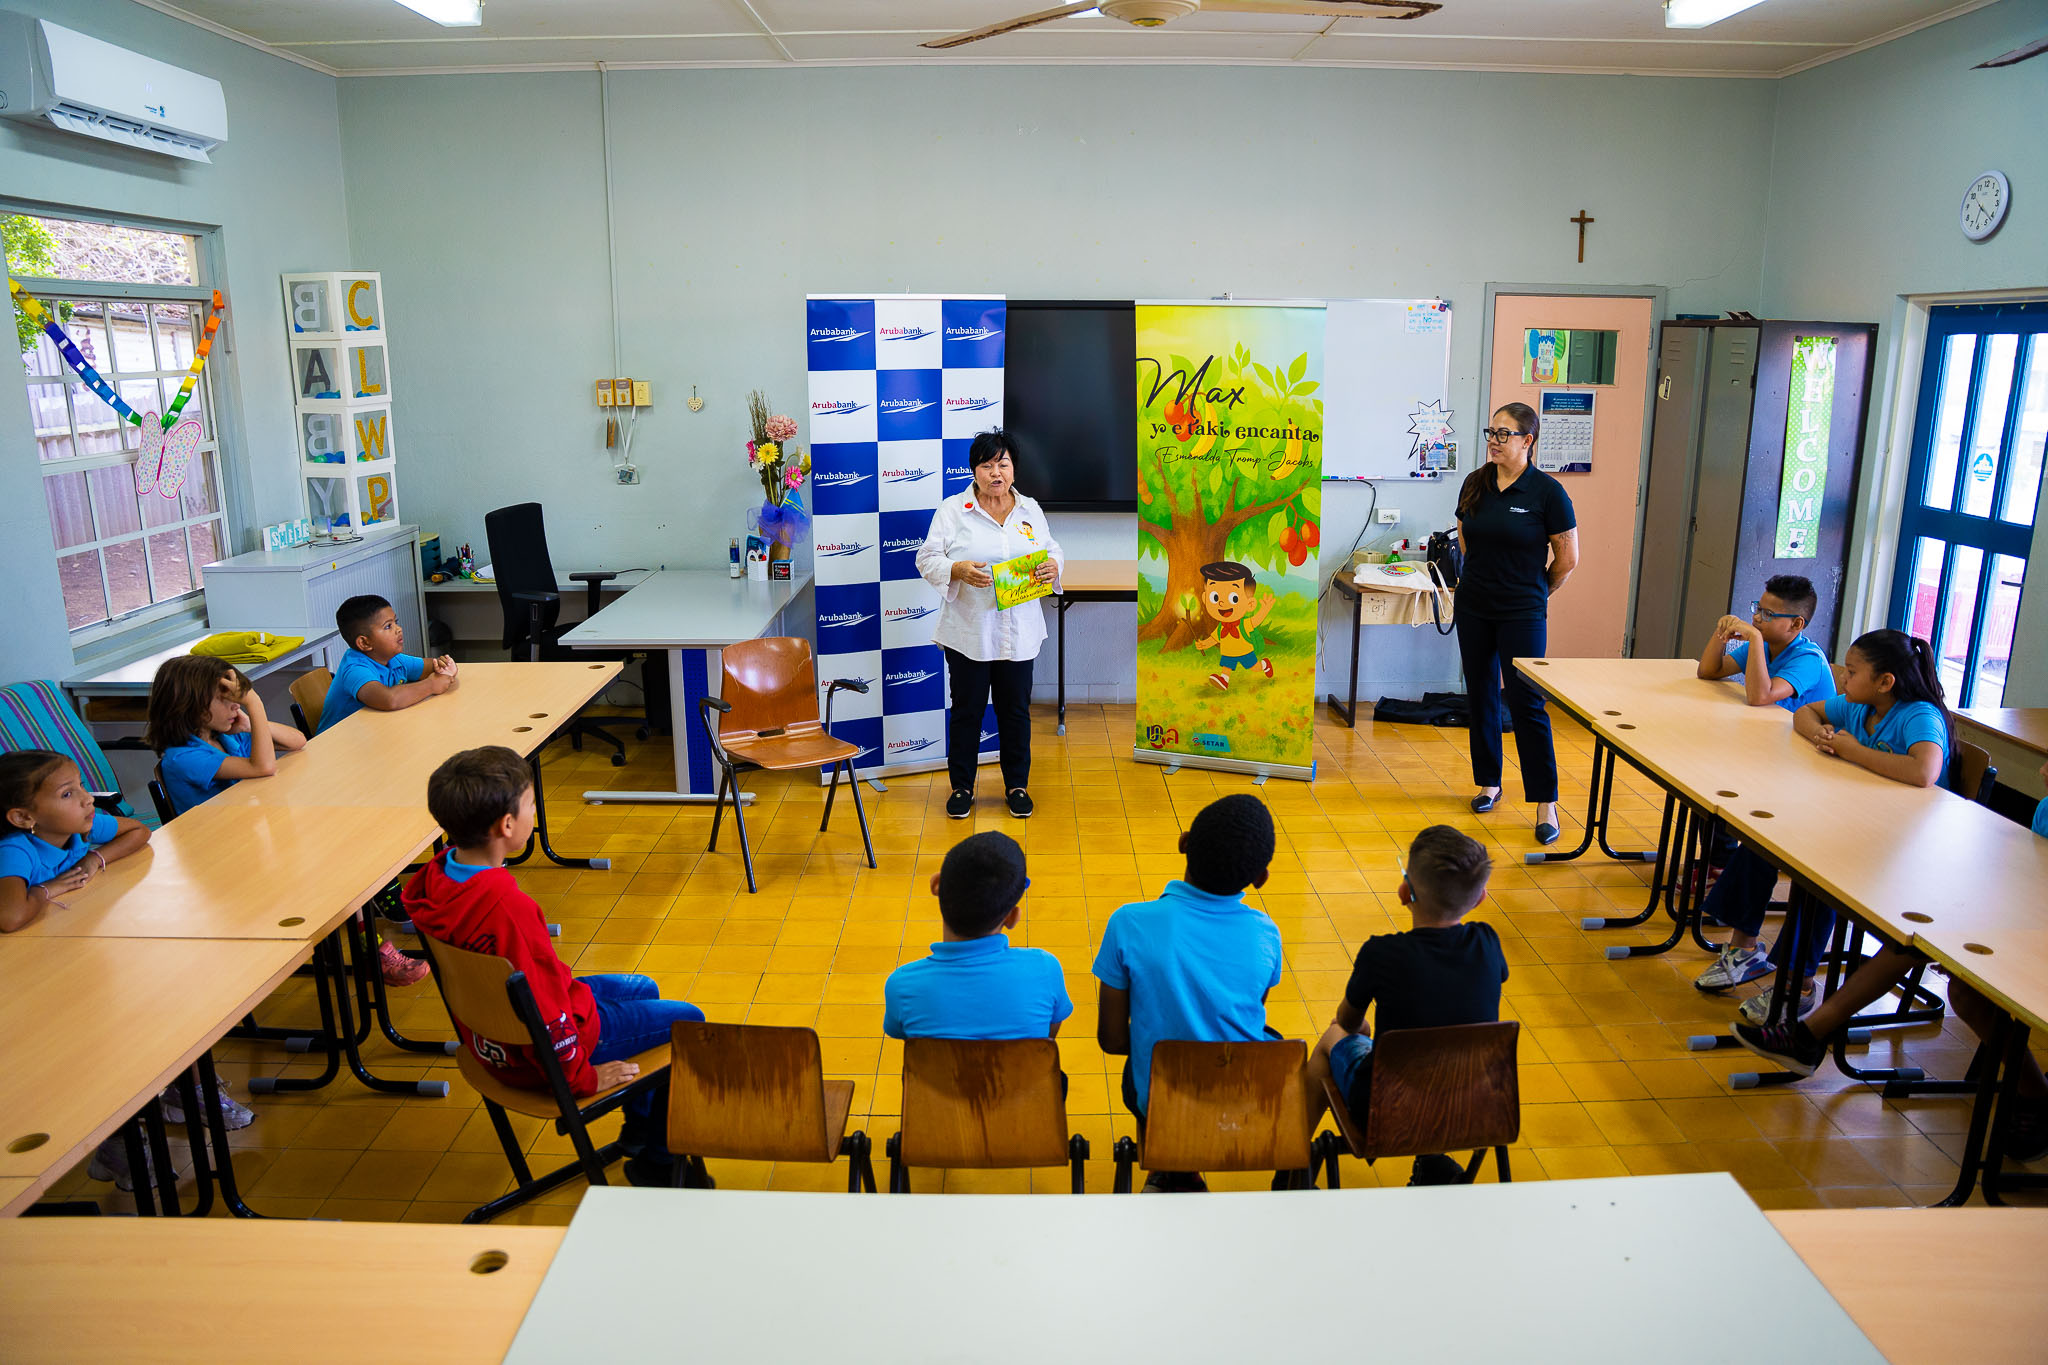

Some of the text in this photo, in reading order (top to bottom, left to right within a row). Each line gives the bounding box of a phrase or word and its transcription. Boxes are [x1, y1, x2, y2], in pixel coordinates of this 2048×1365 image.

[810, 327, 857, 336] Arubabank
[880, 327, 923, 335] Arubabank
[945, 326, 989, 335] Arubabank
[1136, 355, 1245, 419] Max
[812, 400, 857, 409] Arubabank
[880, 399, 923, 407] Arubabank
[945, 398, 988, 406] Arubabank
[1235, 426, 1319, 442] encanta
[1786, 342, 1830, 553] WELCOME
[1155, 446, 1220, 464] Esmeralda
[814, 471, 860, 480] Arubabank
[882, 468, 924, 477] Arubabank
[816, 542, 861, 551] Arubabank
[884, 606, 926, 616] Arubabank
[819, 612, 862, 622] Arubabank
[886, 670, 926, 680] Arubabank
[888, 738, 928, 749] Arubabank
